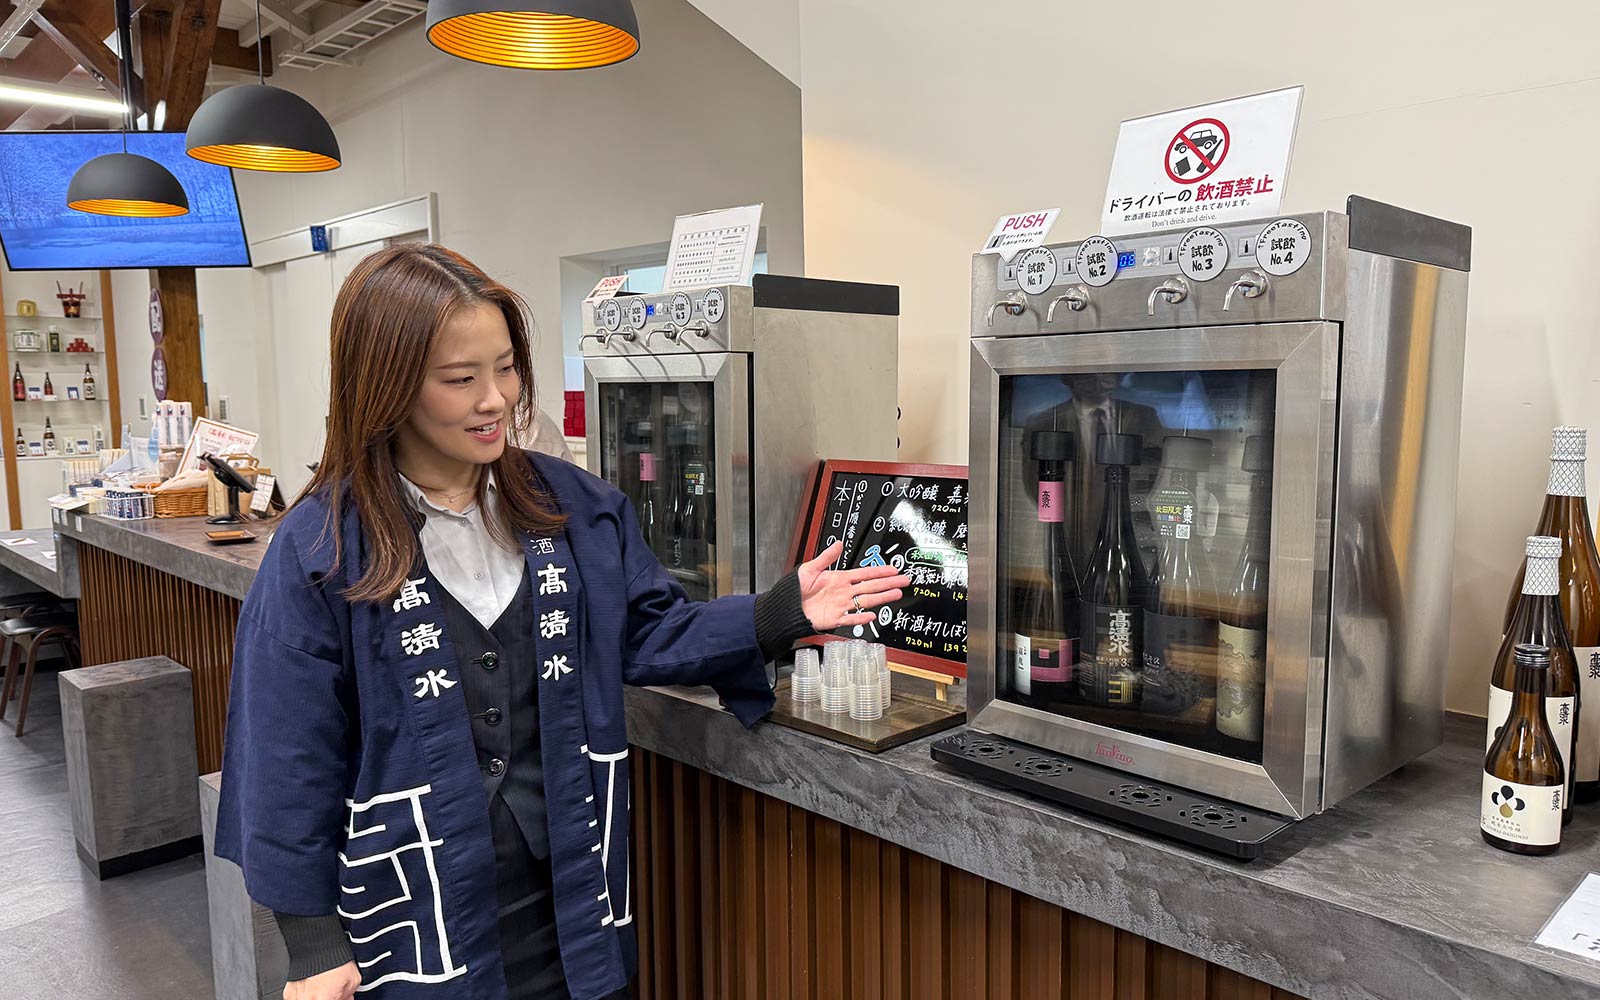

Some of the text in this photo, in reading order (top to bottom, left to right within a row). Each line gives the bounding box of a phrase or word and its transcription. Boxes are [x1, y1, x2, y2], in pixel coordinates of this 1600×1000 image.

[1110, 174, 1274, 213] ドライバーの 飲酒禁止
[1003, 212, 1048, 232] PUSH
[1152, 212, 1217, 228] Don't drink and drive.
[1191, 244, 1214, 258] 試飲
[1270, 237, 1296, 251] 試飲
[1087, 252, 1106, 266] 試飲
[1027, 262, 1046, 274] 試飲
[931, 504, 961, 513] 720ml
[527, 530, 555, 556] 酒
[913, 587, 940, 598] 720ml
[905, 636, 933, 648] 720ml
